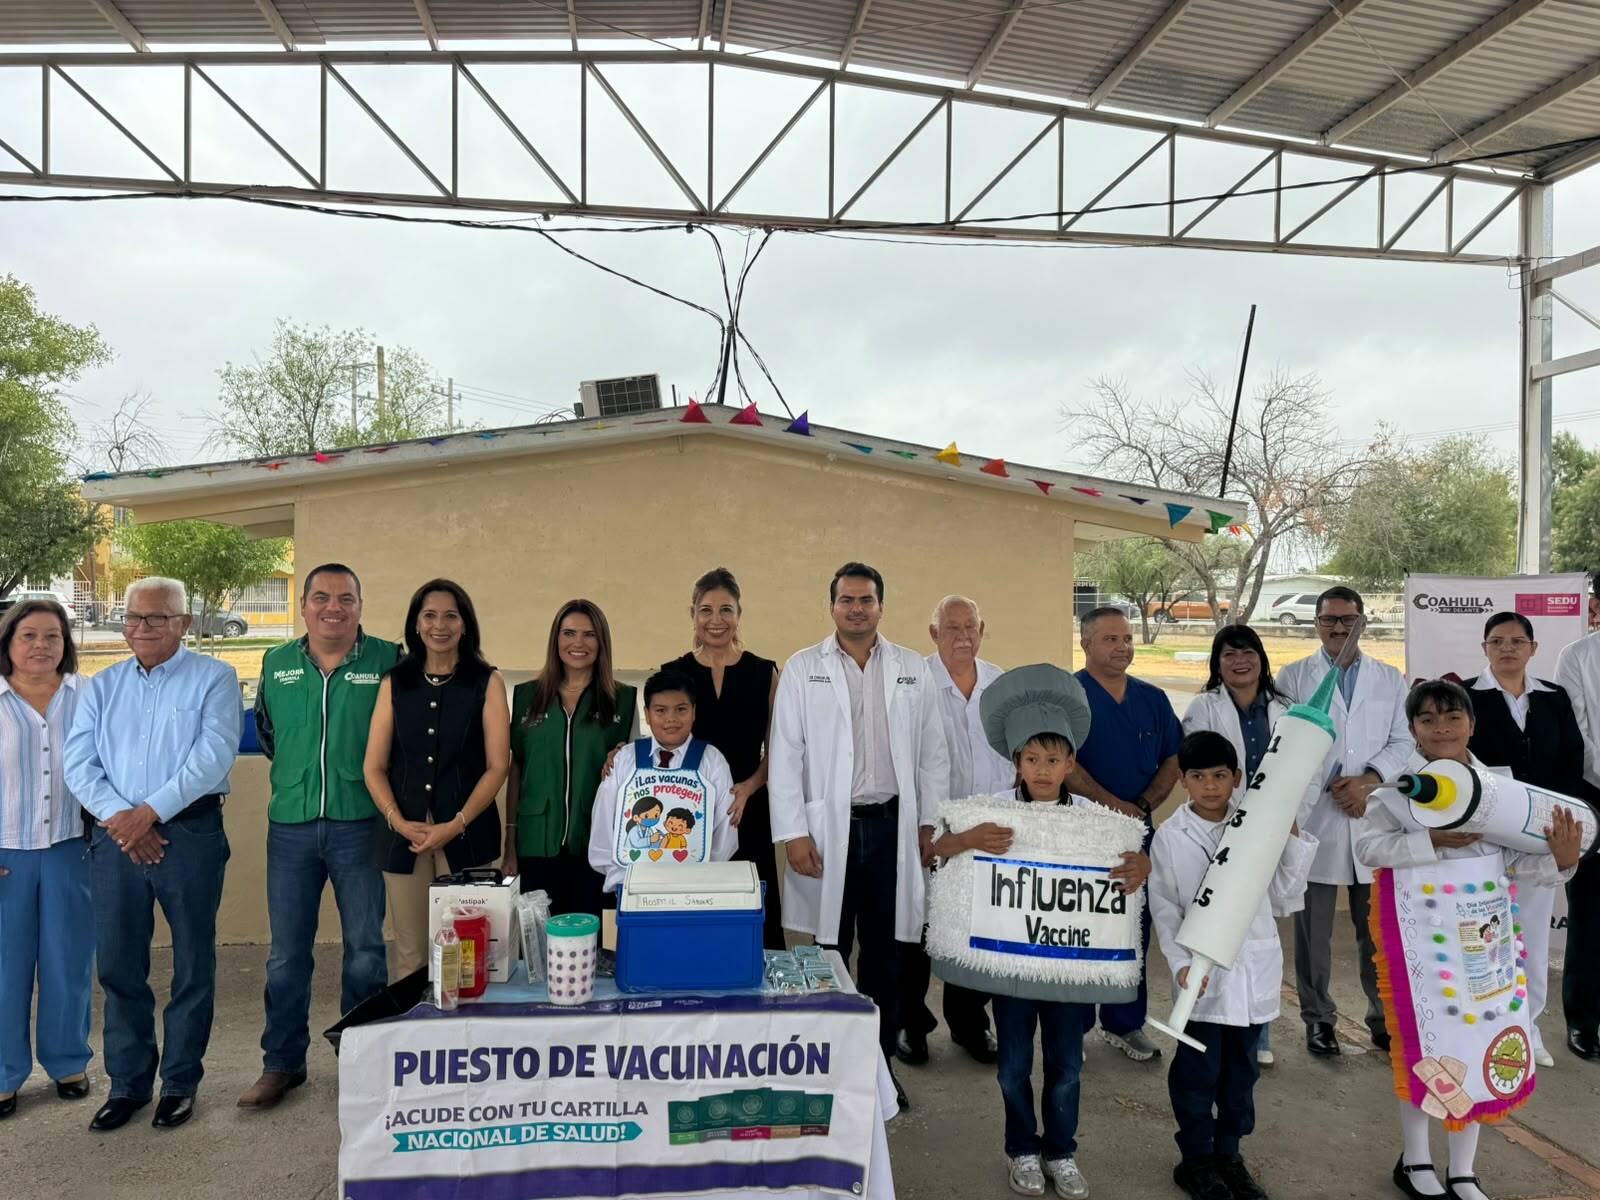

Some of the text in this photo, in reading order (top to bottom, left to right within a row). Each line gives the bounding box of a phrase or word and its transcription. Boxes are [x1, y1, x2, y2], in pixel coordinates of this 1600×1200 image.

[1413, 593, 1494, 610] COAHUILA
[1547, 597, 1577, 605] SEDU
[273, 668, 305, 679] MEJORA
[344, 671, 380, 681] COAHUILA
[1267, 735, 1282, 753] 1
[635, 775, 699, 788] ¡Las vacunas
[1251, 772, 1266, 790] 2
[633, 784, 702, 804] nos protegen!
[1230, 809, 1247, 828] 3
[1215, 846, 1230, 866] 4
[991, 863, 1127, 915] Influenza
[1198, 888, 1214, 907] 5
[1025, 914, 1091, 947] Vaccine
[394, 1034, 831, 1087] PUESTO DE VACUNACIÓN
[385, 1100, 649, 1130] ¡ACUDE CON TU CARTILLA
[407, 1124, 627, 1150] NACIONAL DE SALUD!
